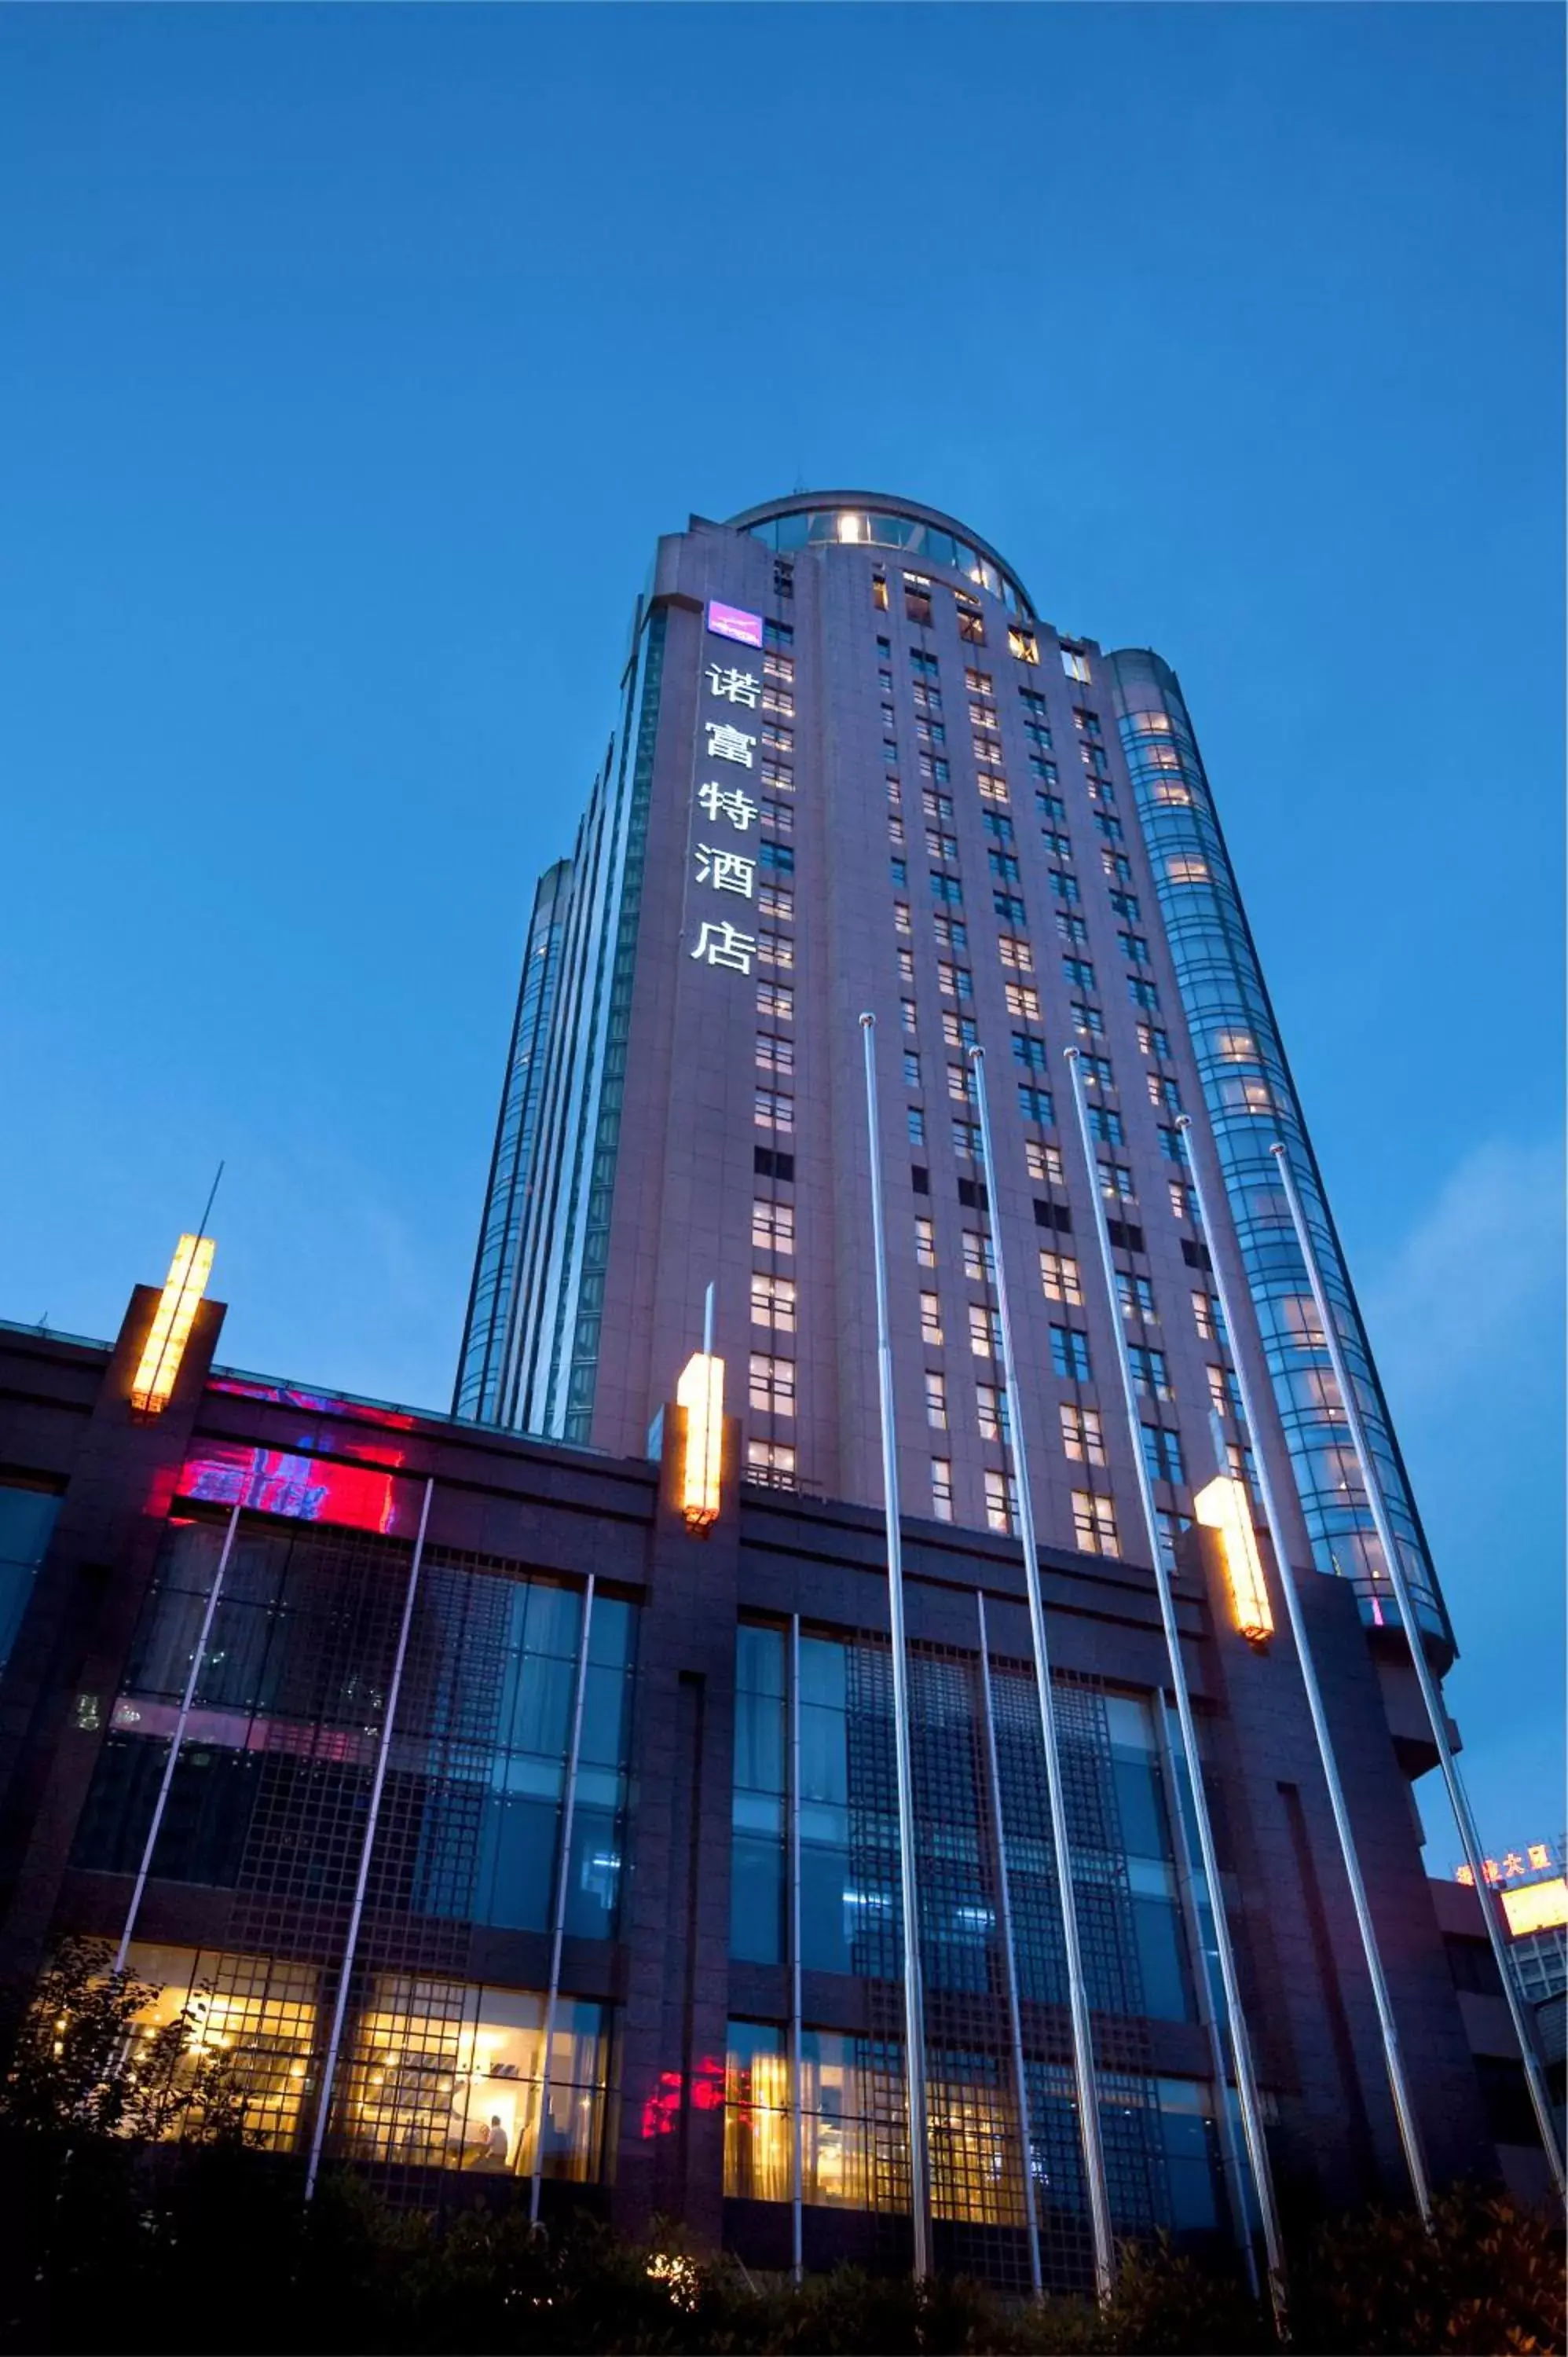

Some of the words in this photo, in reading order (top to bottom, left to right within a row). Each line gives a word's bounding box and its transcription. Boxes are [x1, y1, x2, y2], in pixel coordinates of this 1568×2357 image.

[691, 662, 761, 975] 诺富特酒店
